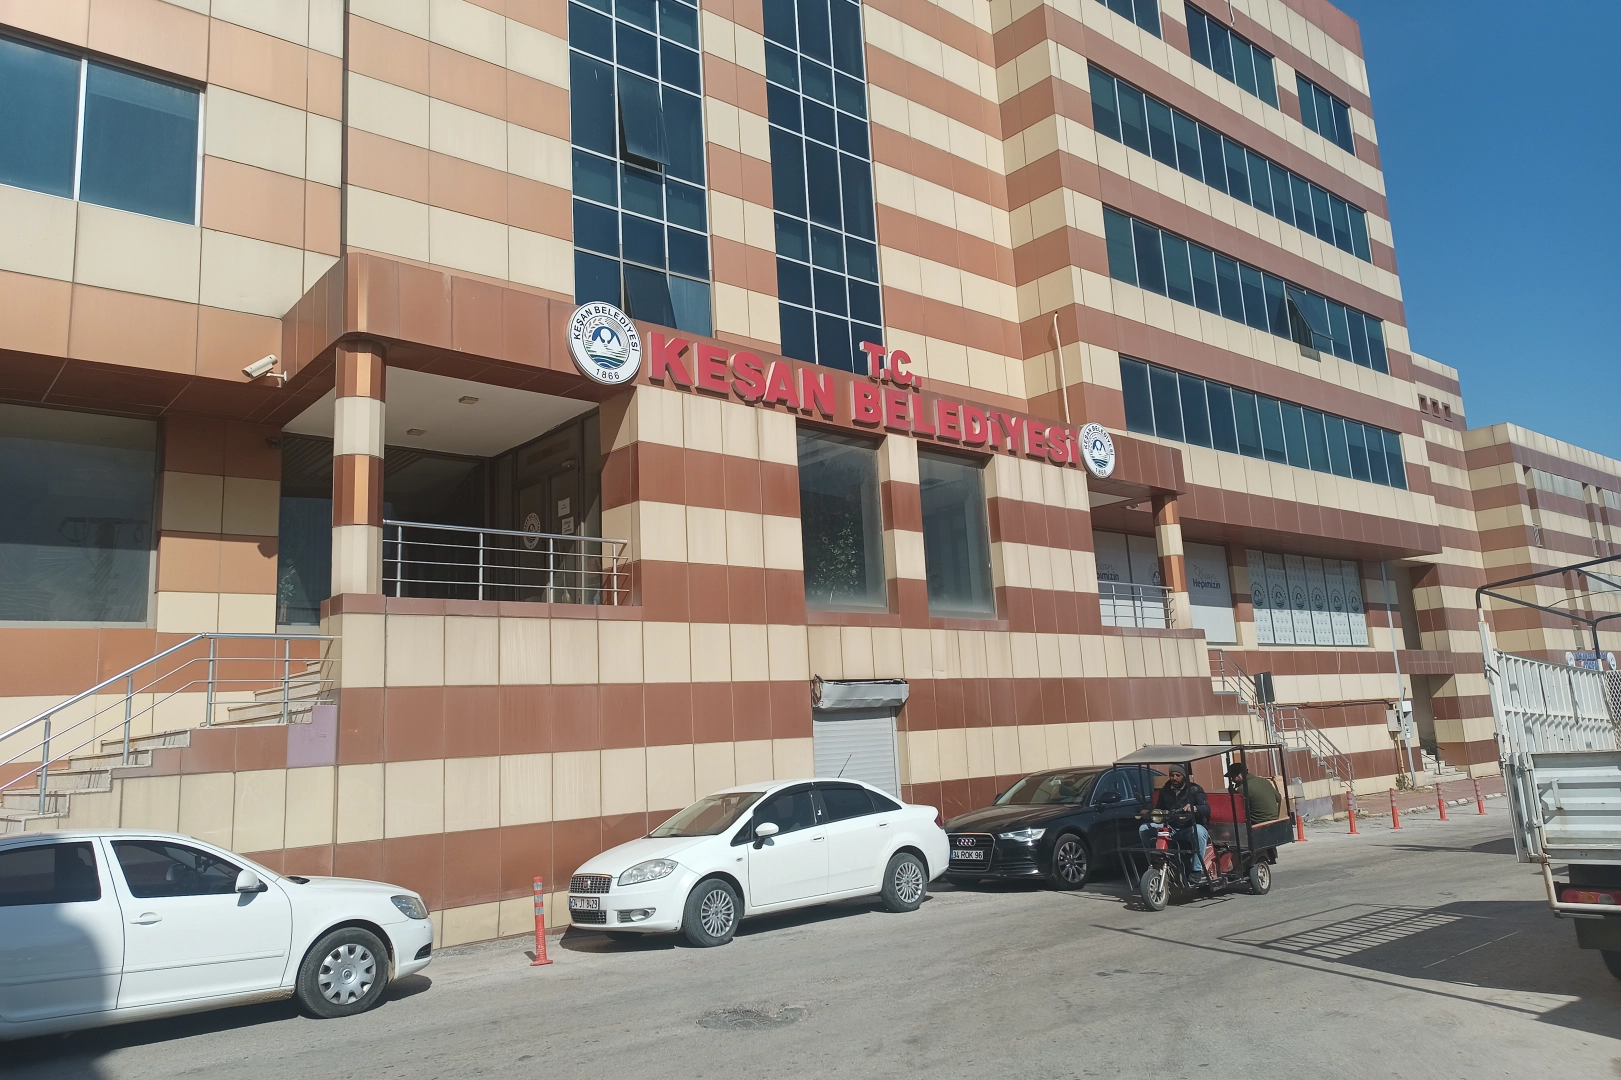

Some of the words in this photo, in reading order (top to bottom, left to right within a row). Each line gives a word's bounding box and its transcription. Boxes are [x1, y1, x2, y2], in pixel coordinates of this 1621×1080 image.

[573, 308, 593, 340] KEŞAN
[596, 368, 620, 380] 1866
[647, 331, 836, 416] KEŞAN
[860, 341, 922, 388] T.C.
